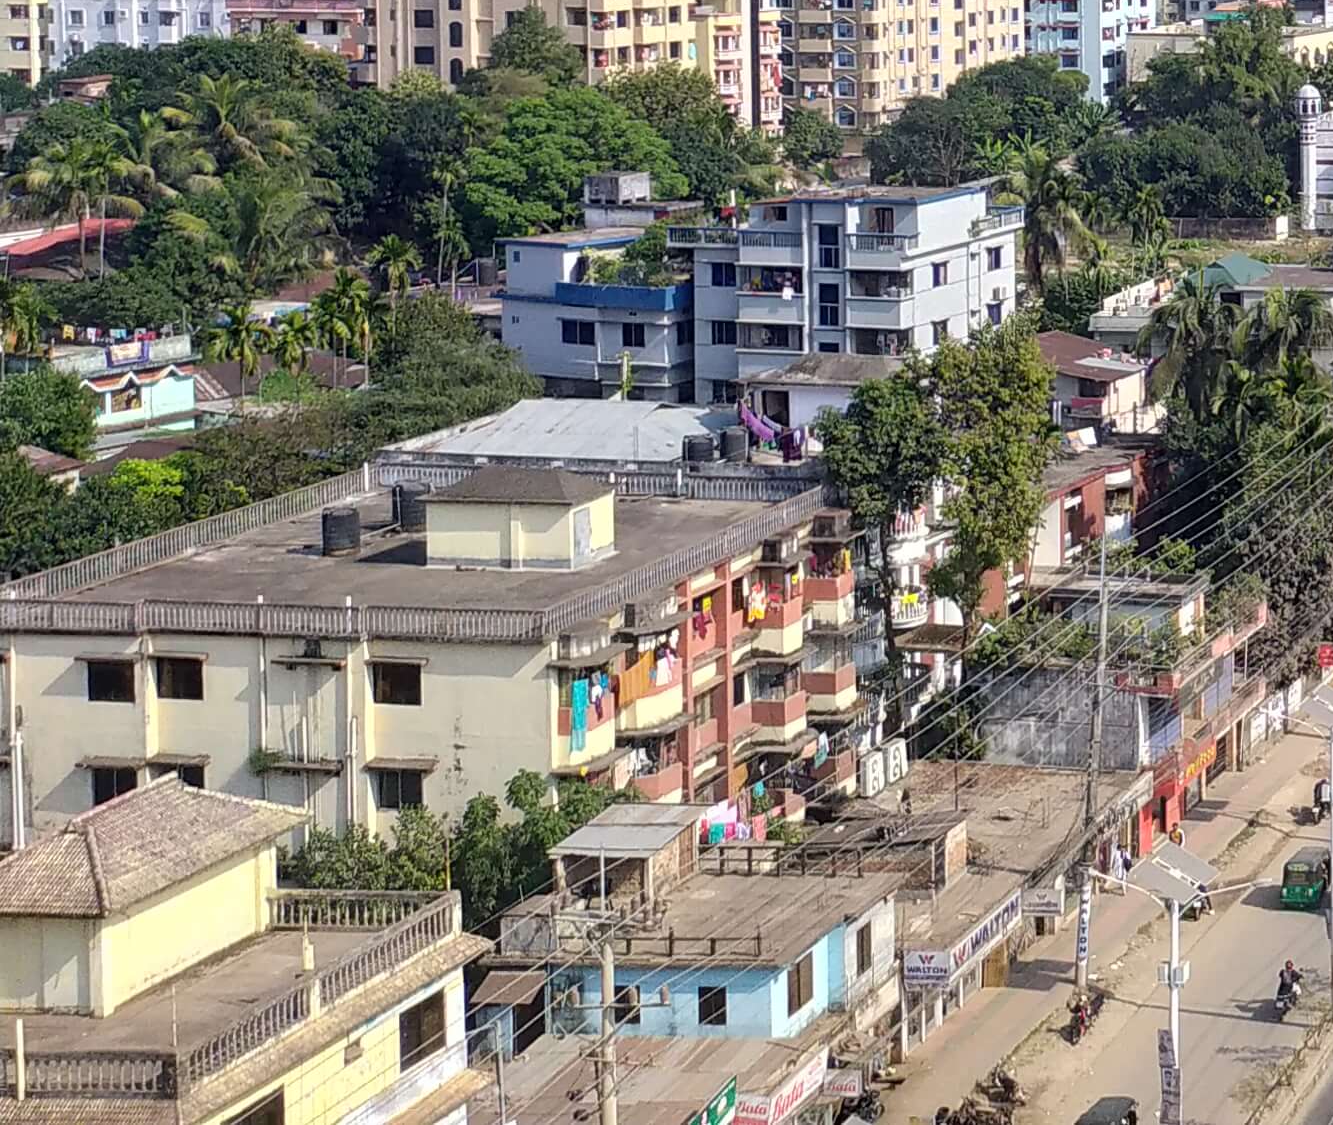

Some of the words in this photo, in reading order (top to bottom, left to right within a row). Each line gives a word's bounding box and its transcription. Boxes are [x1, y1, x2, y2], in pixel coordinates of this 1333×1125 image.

[970, 895, 1020, 957] WALTON
[1079, 898, 1090, 954] WALTON
[907, 965, 947, 974] WALTON
[774, 1082, 804, 1120] Bata
